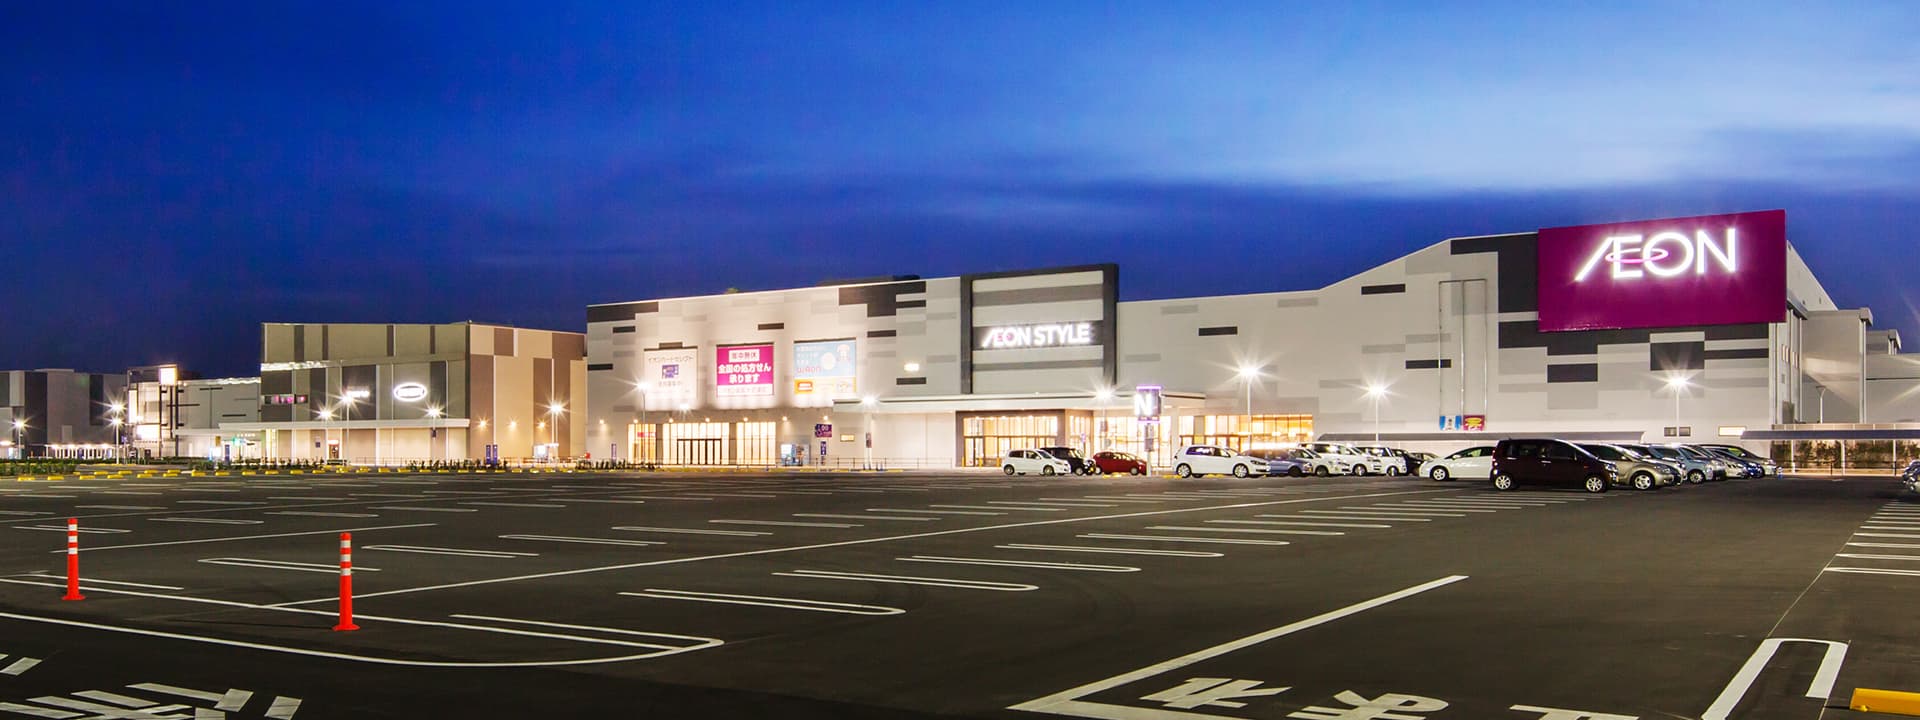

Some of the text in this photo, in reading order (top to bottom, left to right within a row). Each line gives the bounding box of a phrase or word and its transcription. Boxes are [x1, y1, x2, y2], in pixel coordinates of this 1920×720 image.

[1034, 322, 1091, 346] STYLE
[718, 362, 772, 374] 全国の処方せん
[729, 373, 760, 385] 承ります
[1135, 393, 1152, 416] N
